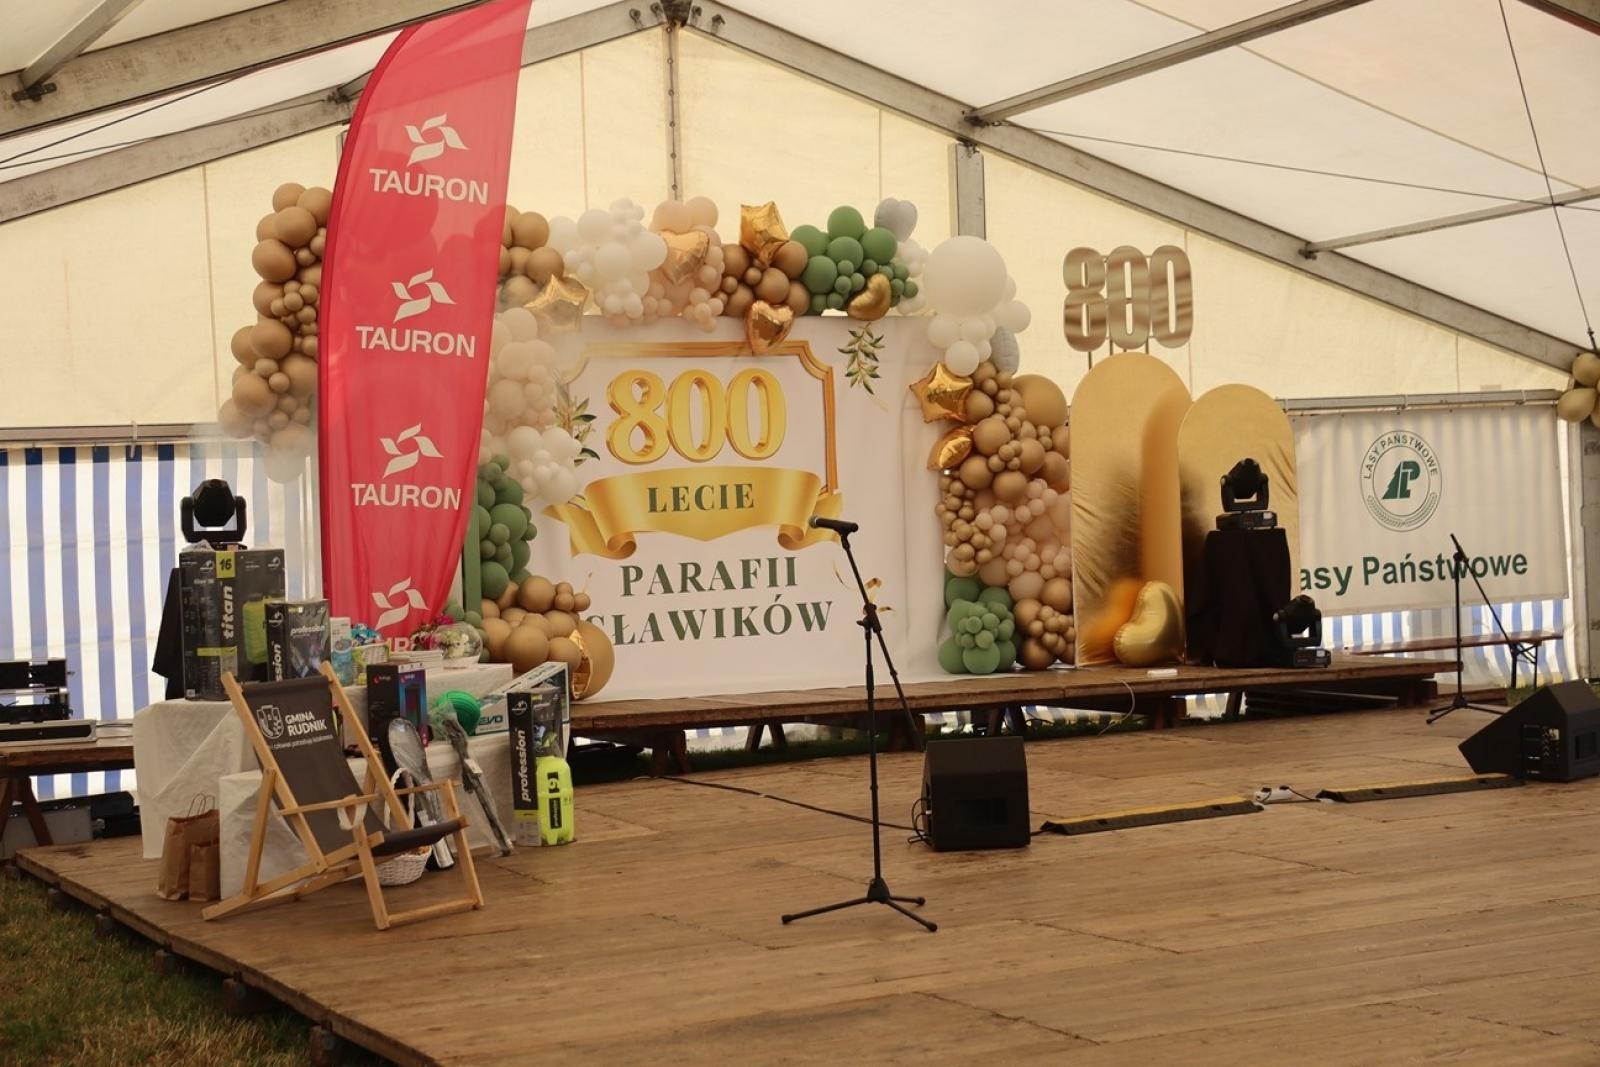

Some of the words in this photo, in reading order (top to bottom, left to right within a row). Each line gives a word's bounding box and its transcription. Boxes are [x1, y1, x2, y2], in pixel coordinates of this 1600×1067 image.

[368, 167, 489, 205] TAURON
[1062, 244, 1194, 352] 800
[355, 325, 477, 358] TAURON
[605, 367, 787, 465] 800
[1363, 447, 1381, 480] LASY
[351, 483, 462, 511] TAURON
[647, 483, 754, 513] LECIE
[219, 558, 232, 571] 16
[620, 556, 798, 597] PARAFII
[1300, 565, 1353, 596] asy
[1362, 552, 1529, 586] Państwowe
[221, 586, 234, 639] titan
[285, 711, 316, 725] GMINA
[287, 719, 328, 736] RUDNIK
[515, 730, 532, 802] profession
